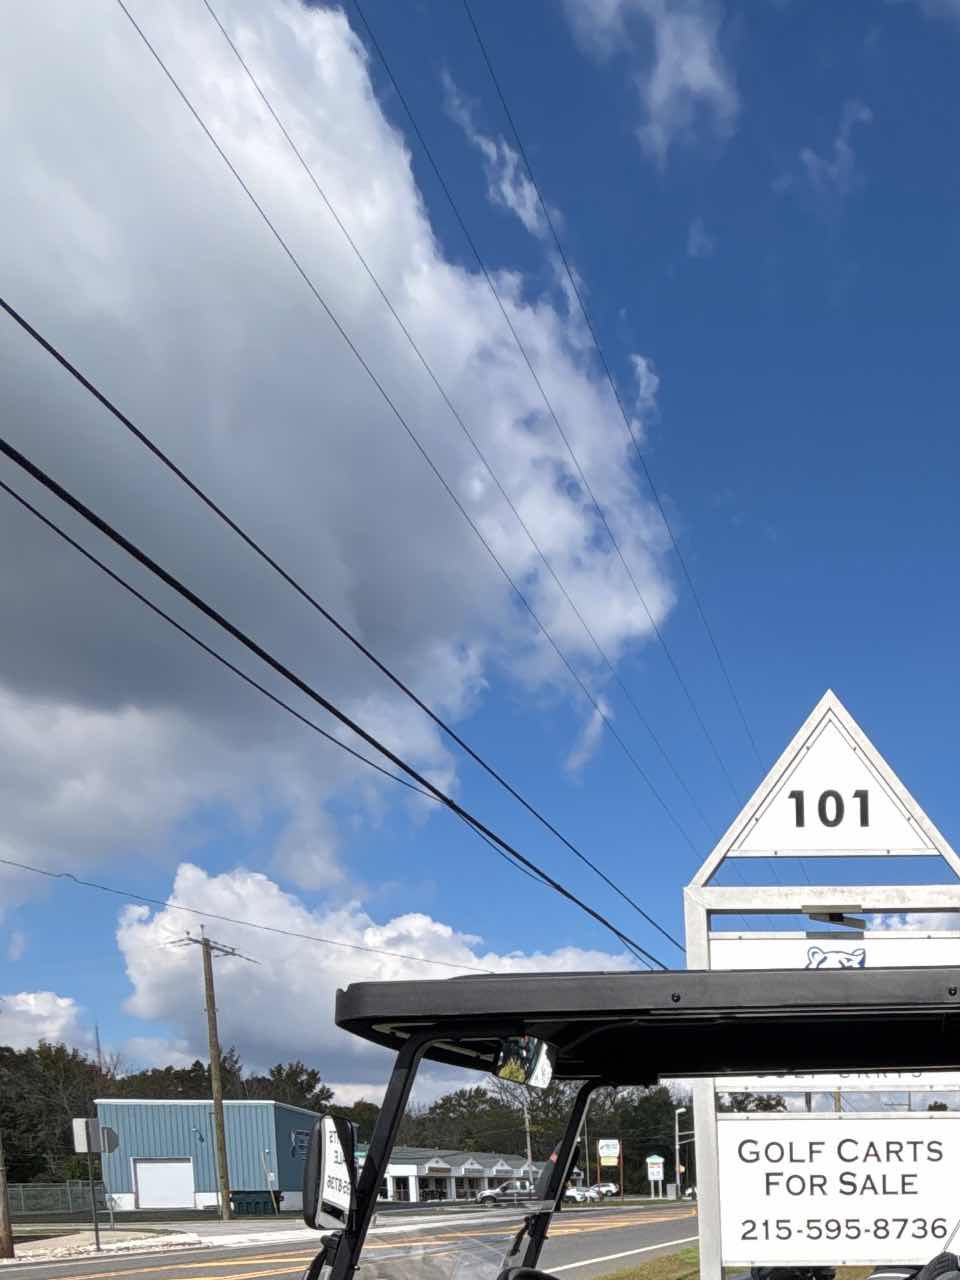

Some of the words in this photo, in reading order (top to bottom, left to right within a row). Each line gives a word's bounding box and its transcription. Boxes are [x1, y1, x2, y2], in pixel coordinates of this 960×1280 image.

[787, 789, 870, 828] 101
[737, 1139, 825, 1164] GOLF
[837, 1138, 944, 1164] CARTS
[765, 1172, 827, 1196] FOR
[839, 1171, 918, 1196] SALE
[741, 1217, 948, 1241] 215-595-8736
